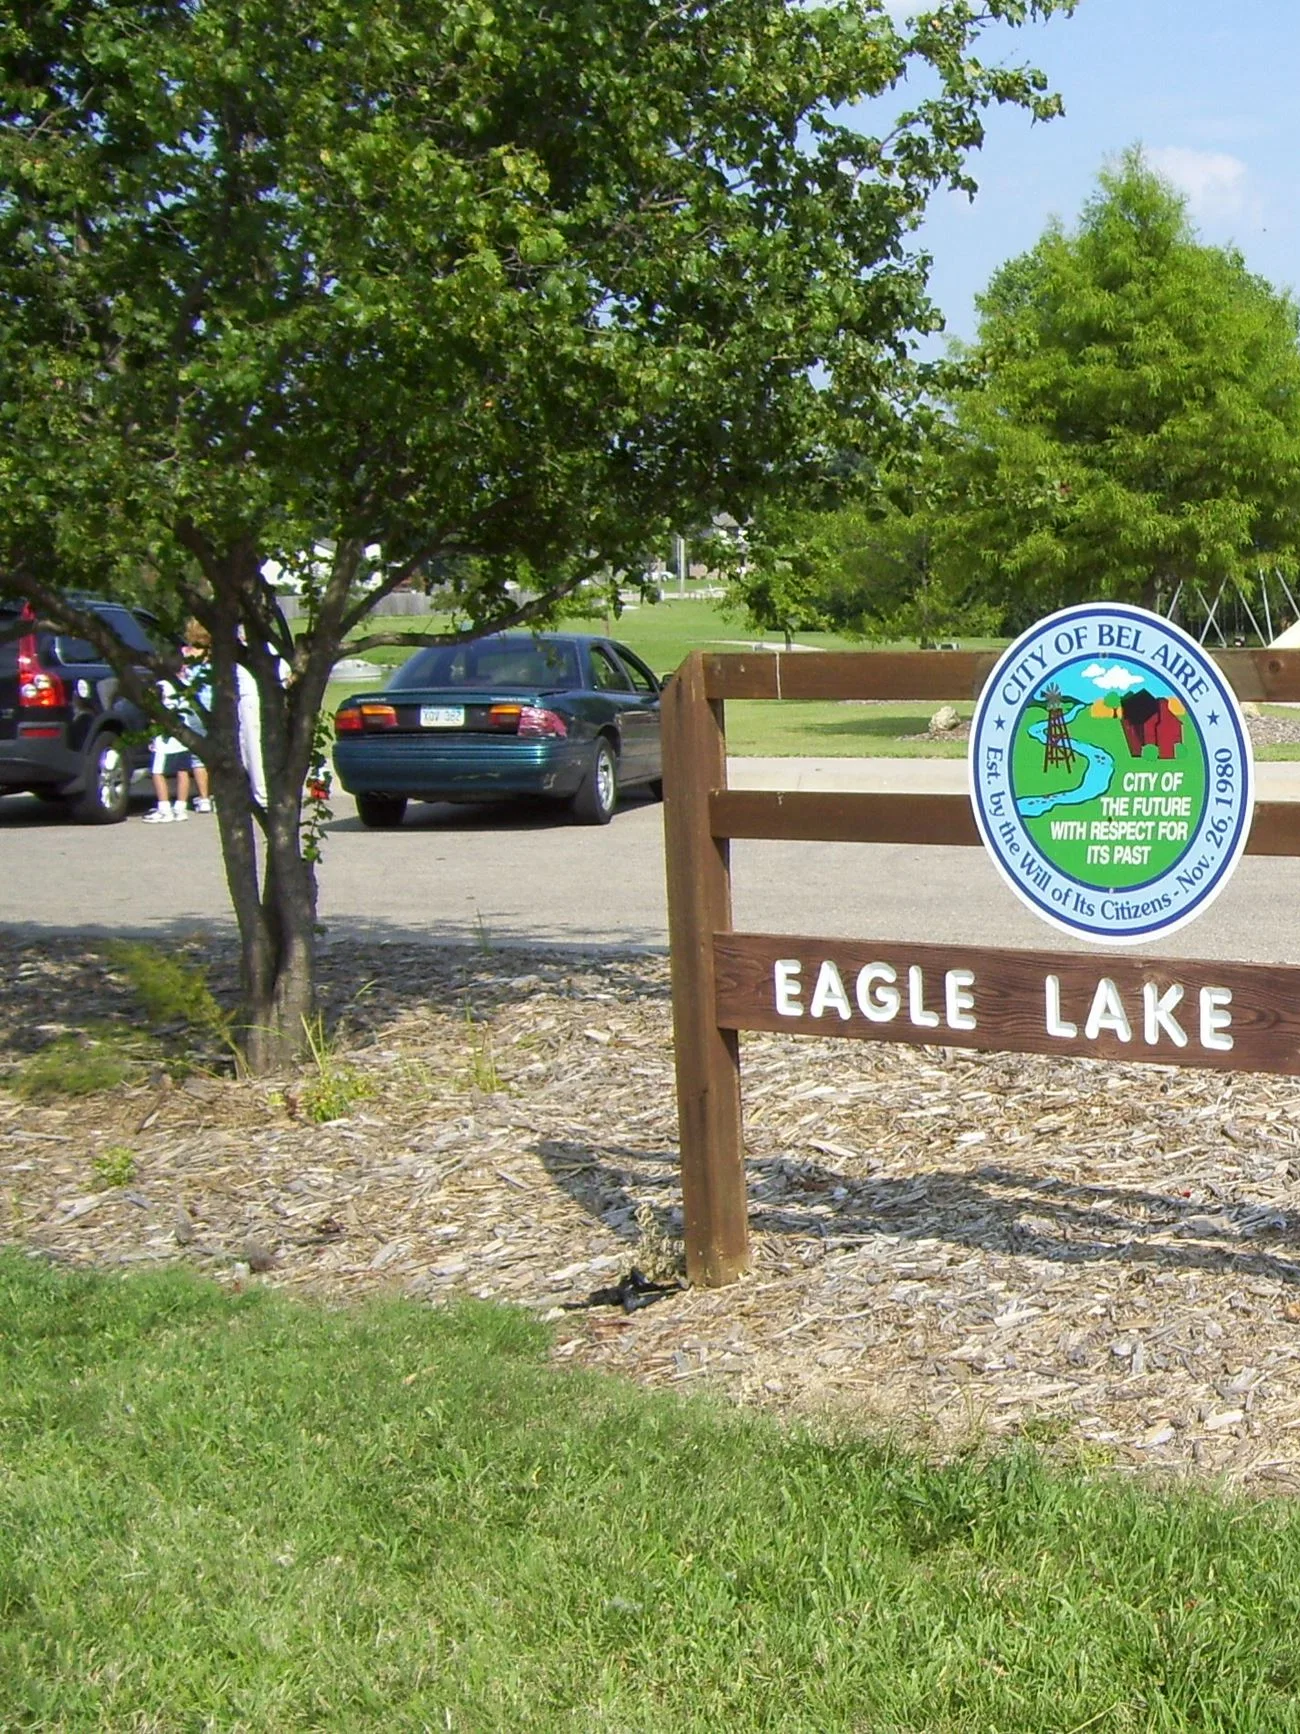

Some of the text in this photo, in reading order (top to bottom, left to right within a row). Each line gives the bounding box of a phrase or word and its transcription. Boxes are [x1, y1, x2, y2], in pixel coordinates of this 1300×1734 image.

[1001, 623, 1210, 706] CITY OF BEL AIRE
[986, 746, 1004, 785] Est.
[1213, 747, 1235, 810] 1980
[1123, 771, 1184, 792] CITY OF
[989, 791, 1006, 817] by
[1100, 796, 1192, 817] THE FUTURE
[998, 821, 1021, 855] the
[1050, 820, 1189, 841] WITH RESPECT FOR
[1205, 815, 1234, 849] 26,
[1086, 844, 1152, 865] ITS PAST
[1019, 851, 1052, 892] Will
[1175, 853, 1216, 894] Nov.
[1051, 886, 1070, 907] of
[1072, 891, 1096, 917] Its
[1100, 892, 1172, 921] Citizens
[774, 958, 977, 1031] EAGLE
[1045, 973, 1235, 1052] LAKE
